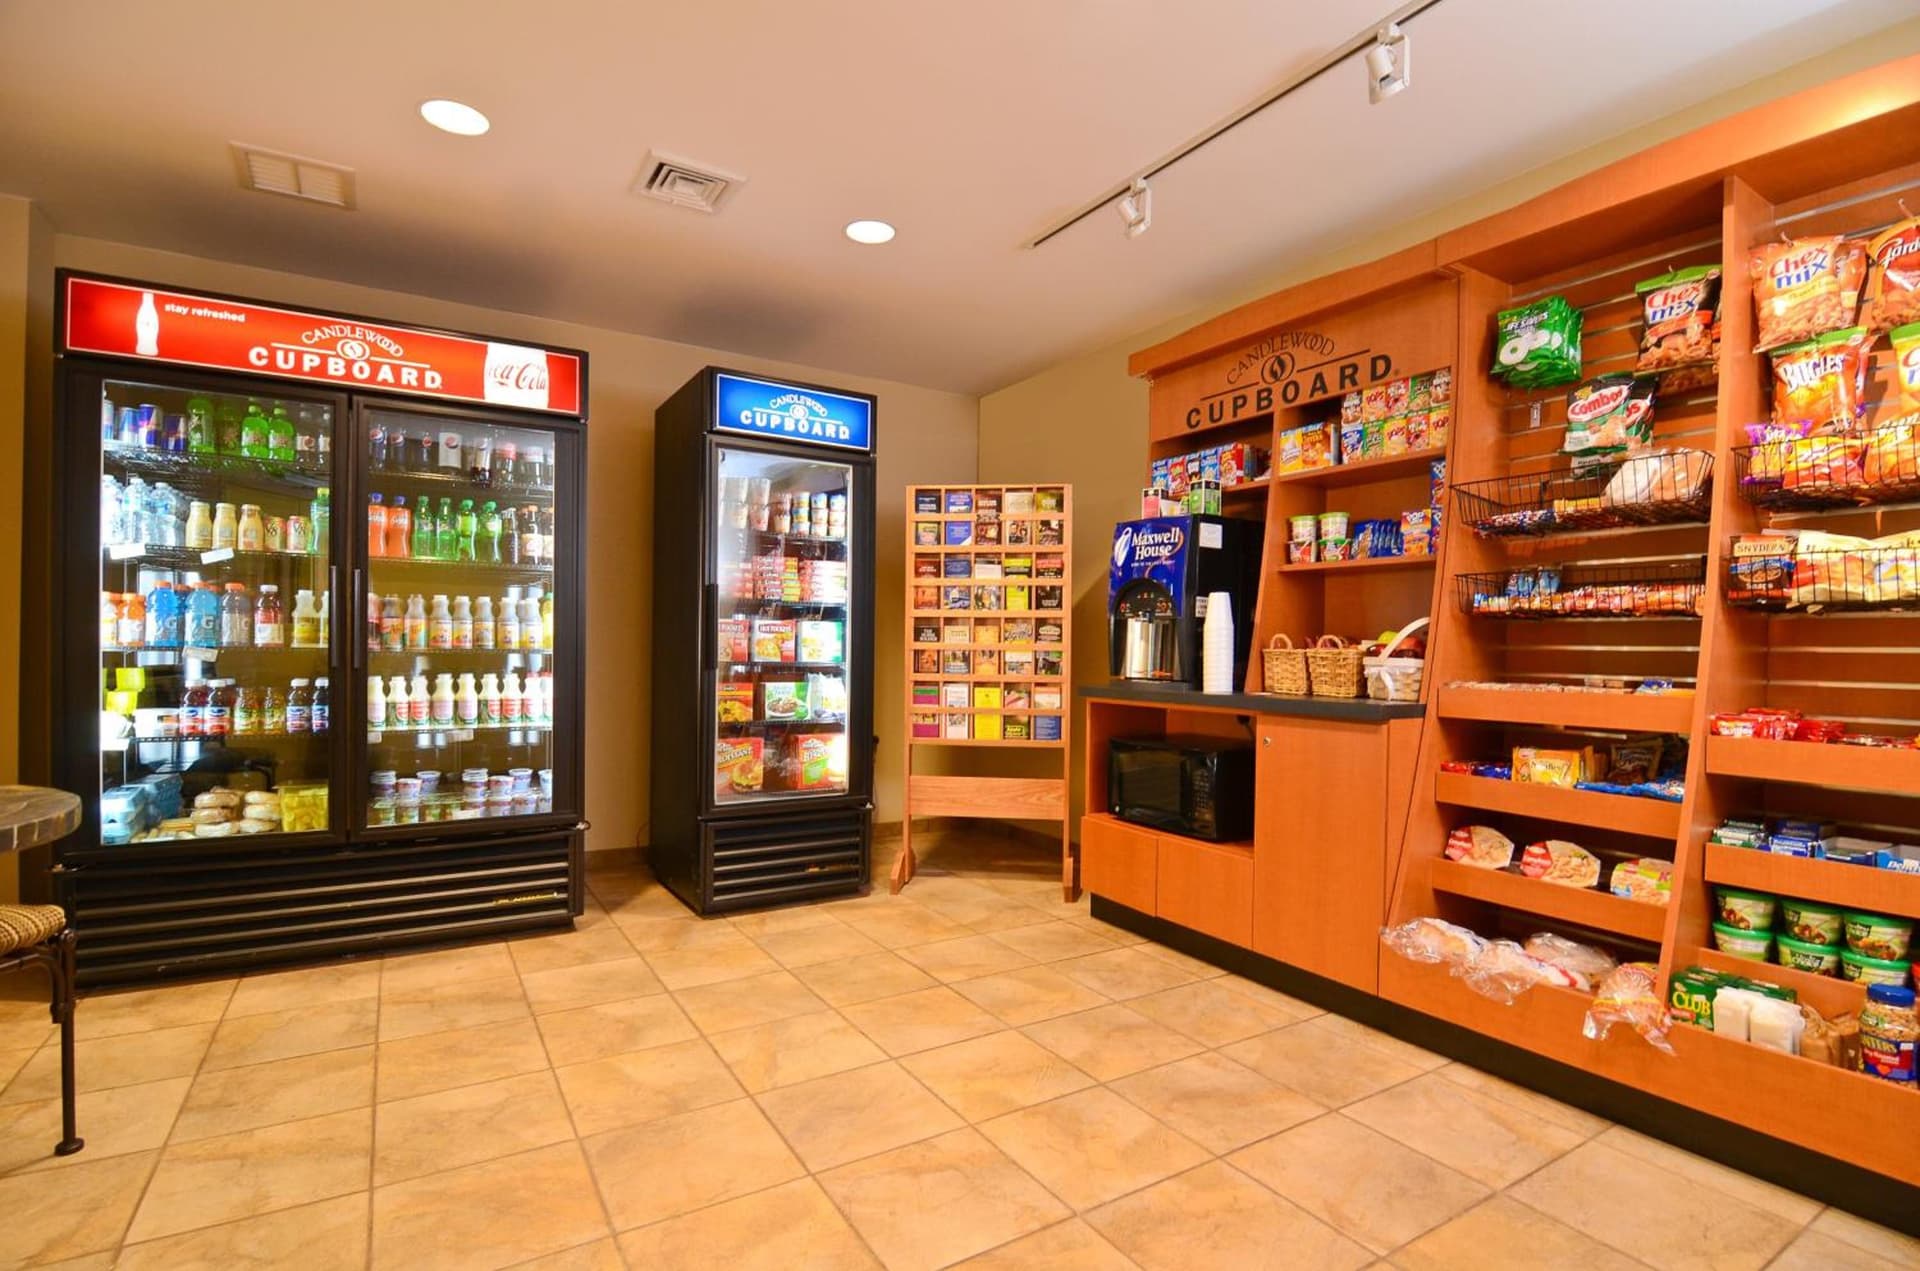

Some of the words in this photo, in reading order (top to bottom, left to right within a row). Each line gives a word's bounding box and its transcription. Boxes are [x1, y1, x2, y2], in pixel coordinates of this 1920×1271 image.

[1769, 247, 1826, 278] Chex
[1776, 256, 1827, 288] mix
[1647, 285, 1700, 308] Chex
[164, 302, 189, 316] stay
[191, 307, 246, 322] refreshed
[301, 324, 404, 358] CANDLEWOOD
[248, 346, 443, 390] CUPBOARD
[1227, 331, 1335, 385] CANDLEWOOD
[769, 394, 828, 417] CANDLEWOOD
[1186, 354, 1392, 429] CUPBOARD
[739, 409, 850, 440] CUPBOARD
[1131, 527, 1180, 547] Maxwell
[1135, 545, 1172, 560] House
[202, 615, 214, 629] G
[1672, 991, 1711, 1017] CLUB
